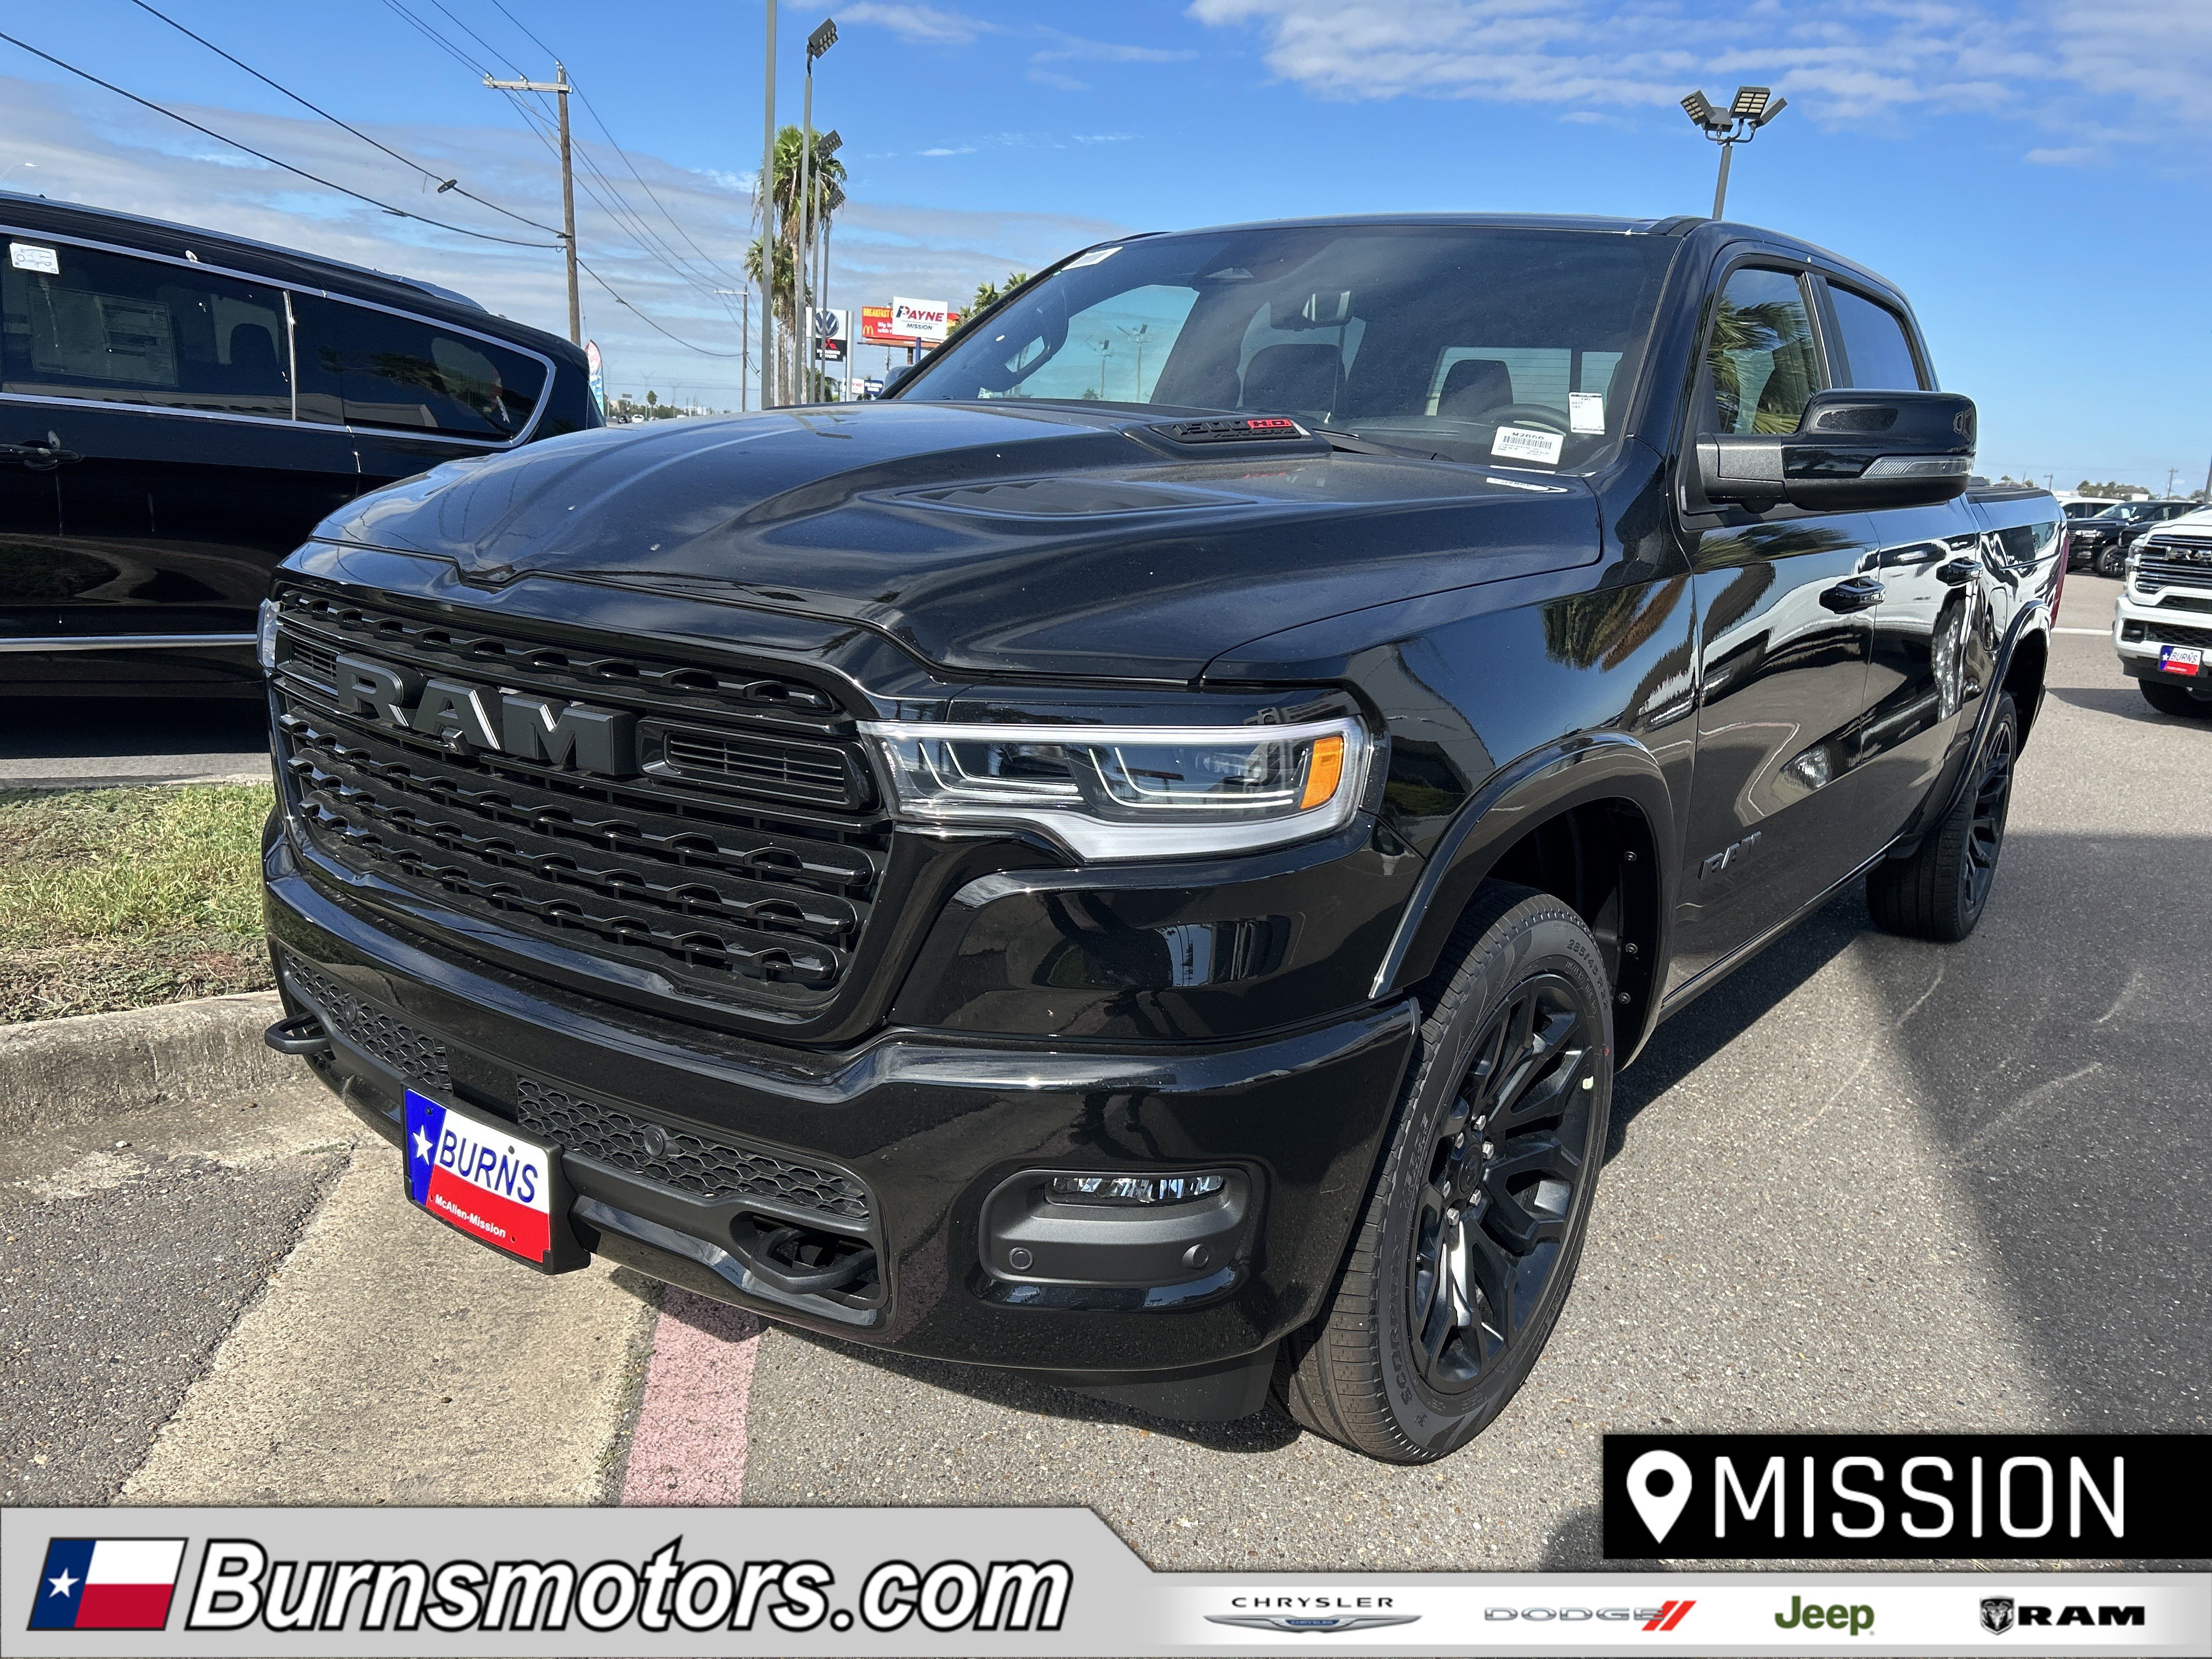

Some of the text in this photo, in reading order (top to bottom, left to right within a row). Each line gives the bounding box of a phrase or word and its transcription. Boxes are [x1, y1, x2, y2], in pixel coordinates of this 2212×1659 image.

[863, 308, 890, 318] BREAKFAST
[896, 306, 944, 322] PAYNE
[1171, 420, 1251, 436] 1500
[2171, 652, 2198, 663] BURNS
[335, 651, 637, 776] RAM
[439, 1128, 539, 1203] BURNS
[435, 1194, 506, 1238] McAllen-Mission
